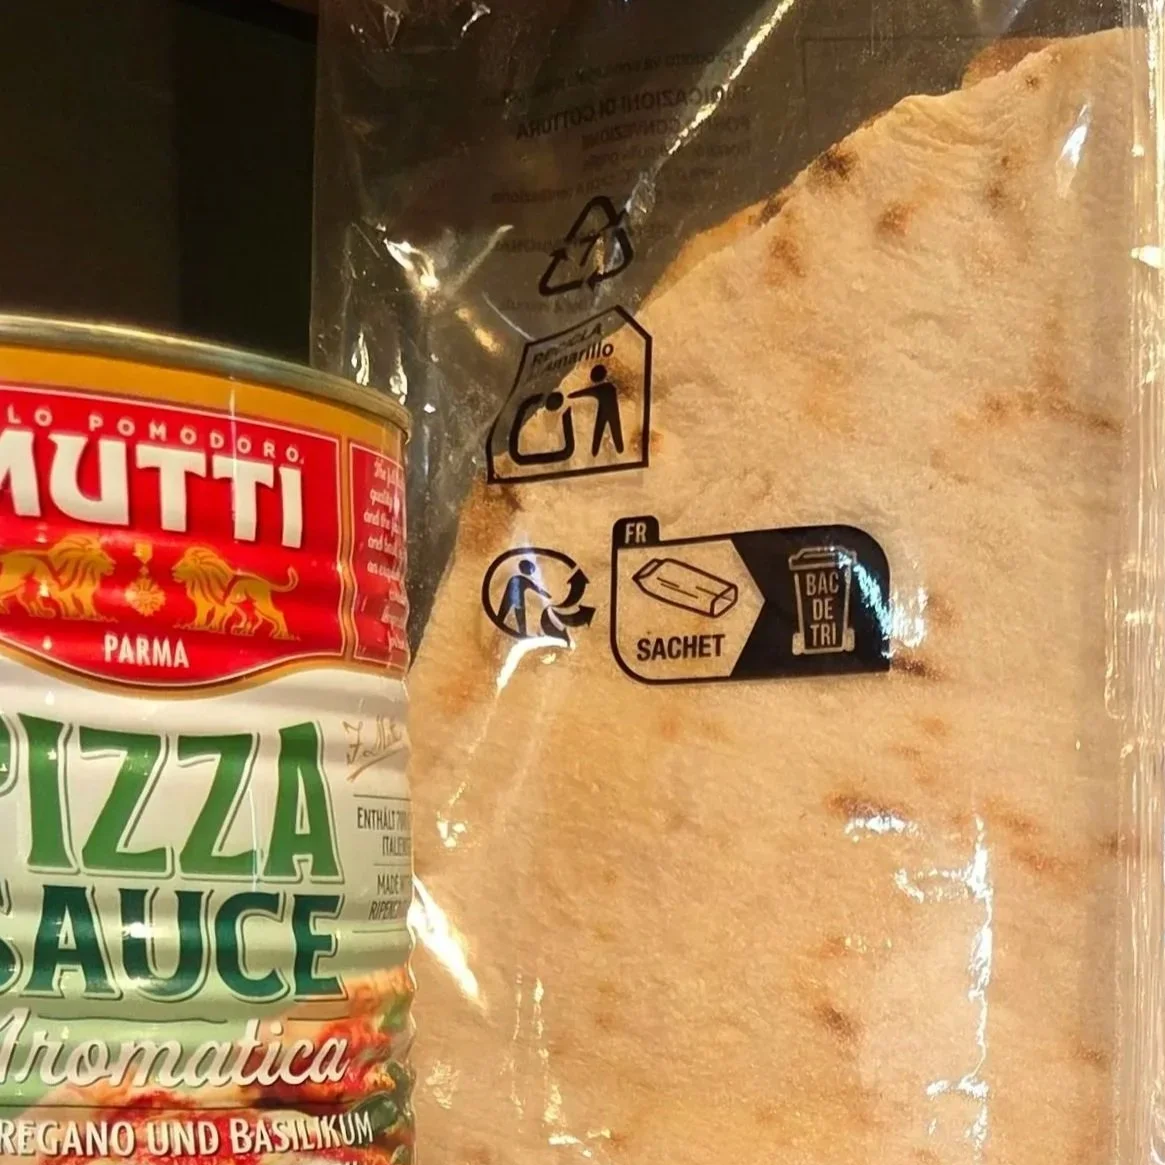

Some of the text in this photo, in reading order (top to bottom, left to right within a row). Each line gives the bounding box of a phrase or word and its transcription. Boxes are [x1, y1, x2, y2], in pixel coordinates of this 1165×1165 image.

[88, 410, 302, 463] POMODORO
[624, 521, 648, 545] FR
[806, 571, 840, 596] BAC
[812, 597, 834, 621] DE
[636, 634, 726, 662] SACHET
[810, 622, 837, 647] TRI
[103, 633, 190, 669] PARMA
[0, 712, 346, 885] IZZA
[377, 872, 400, 896] MADE
[0, 882, 348, 1004] AUCE
[147, 1119, 220, 1158] UND
[229, 1112, 375, 1158] BASILIKUM
